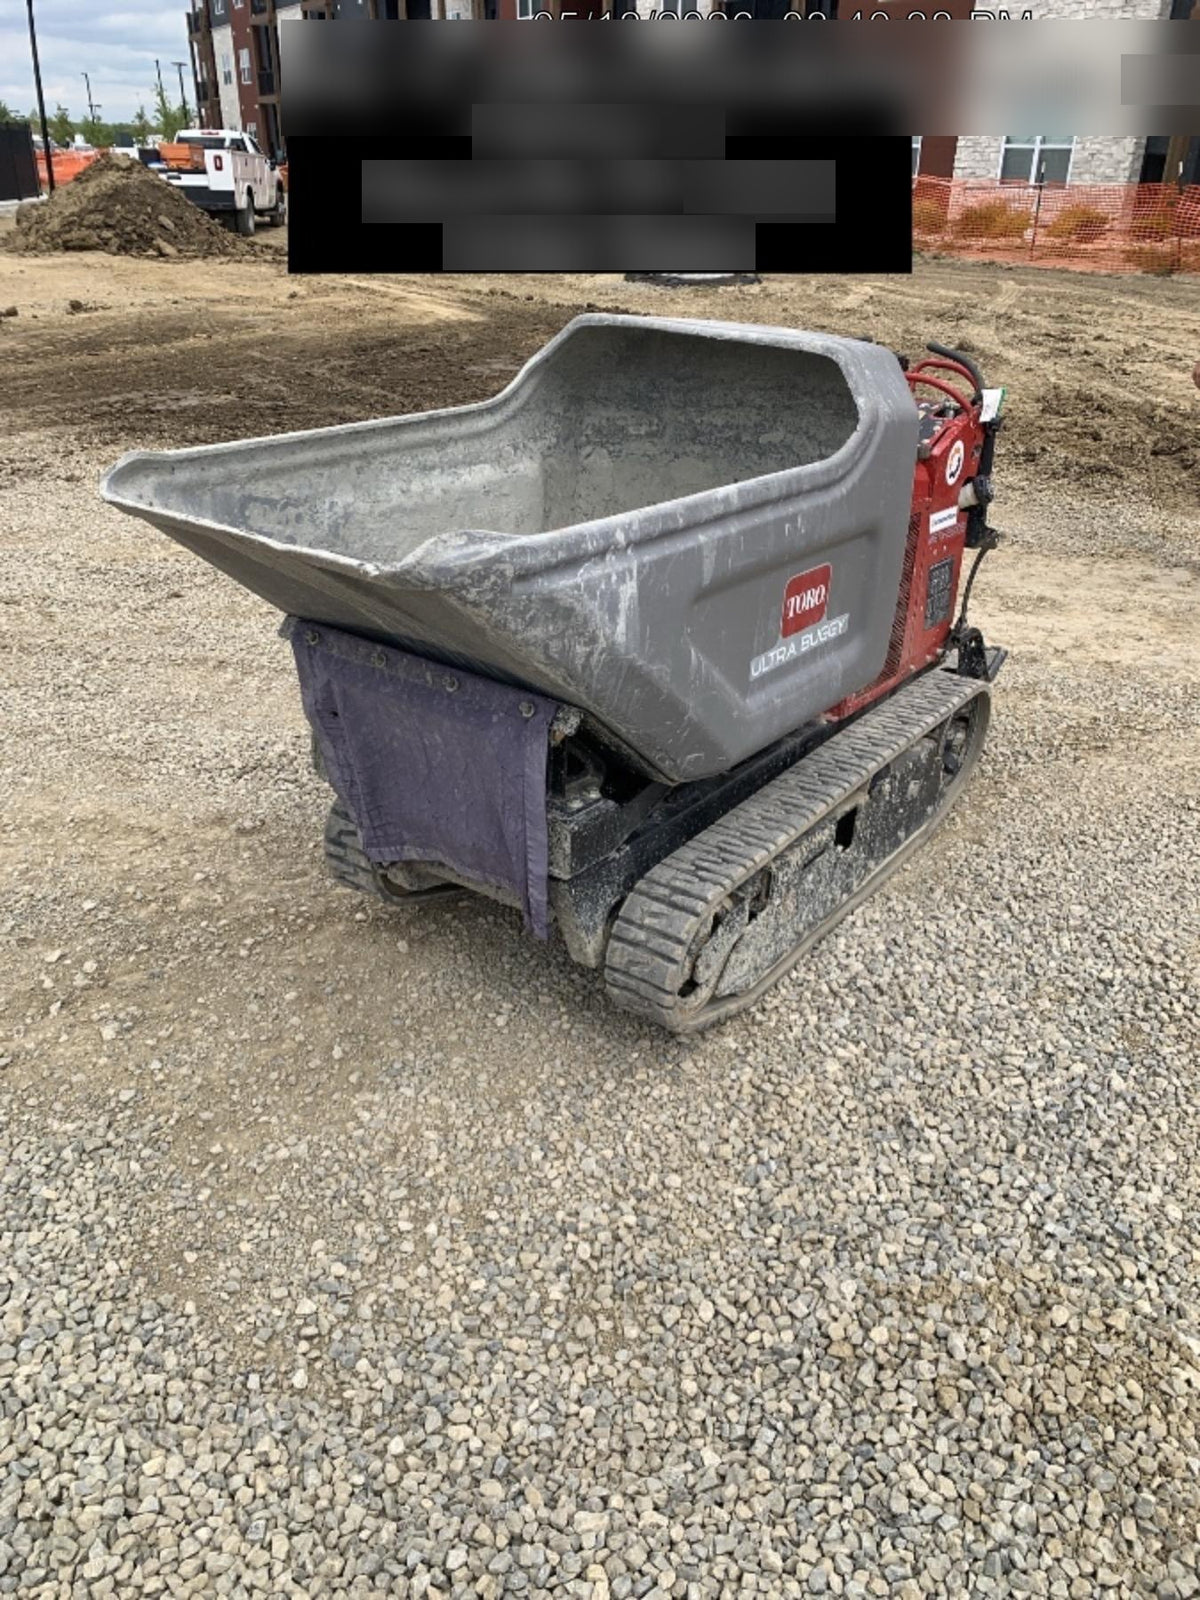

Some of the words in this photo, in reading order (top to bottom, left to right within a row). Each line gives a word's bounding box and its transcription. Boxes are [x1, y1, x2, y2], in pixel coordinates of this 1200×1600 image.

[787, 584, 826, 619] TORO
[750, 642, 796, 677] ULTRA
[800, 618, 846, 652] BUGGY
